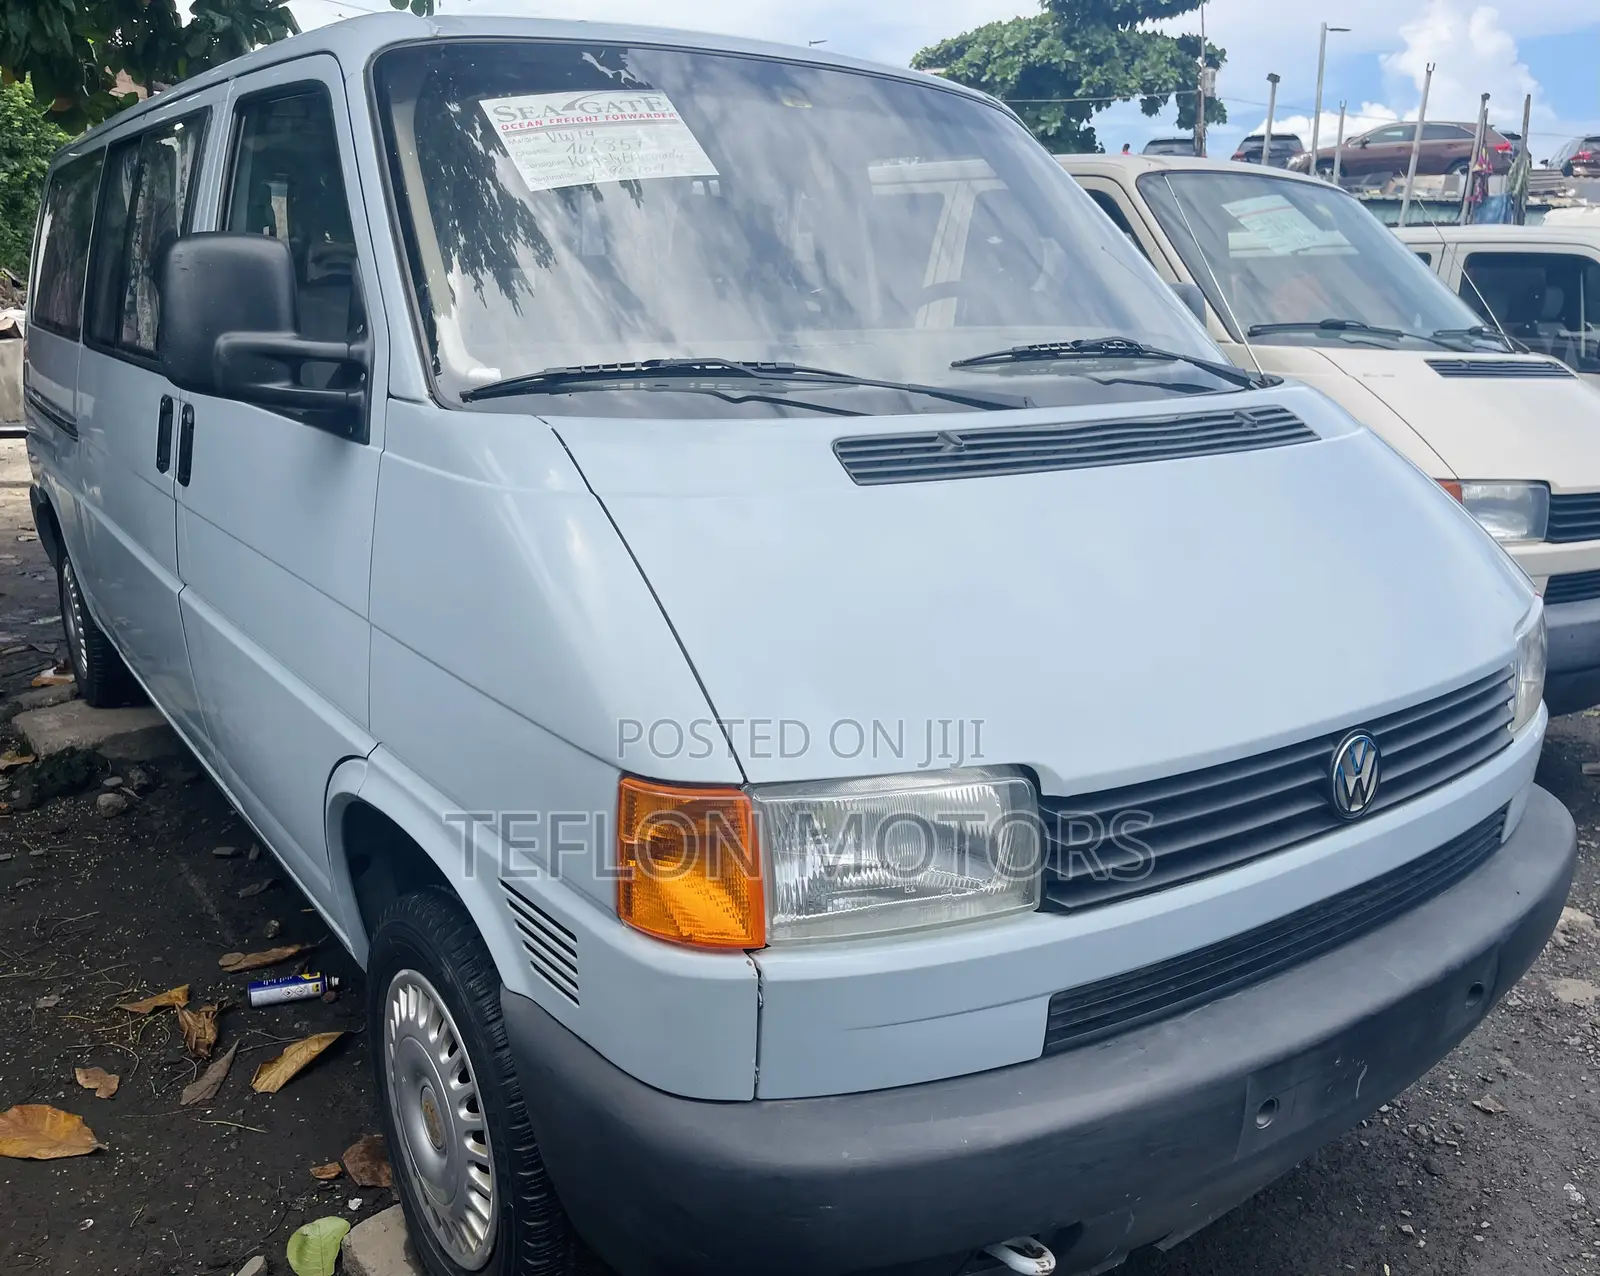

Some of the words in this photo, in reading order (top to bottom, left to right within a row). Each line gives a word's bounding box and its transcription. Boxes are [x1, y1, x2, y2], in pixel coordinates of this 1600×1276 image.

[492, 104, 565, 122] SEA
[579, 96, 669, 114] GATE
[501, 119, 543, 131] OCEAN
[549, 115, 598, 124] FREIGHT
[605, 112, 675, 121] FORWARDER
[1333, 735, 1379, 815] VW
